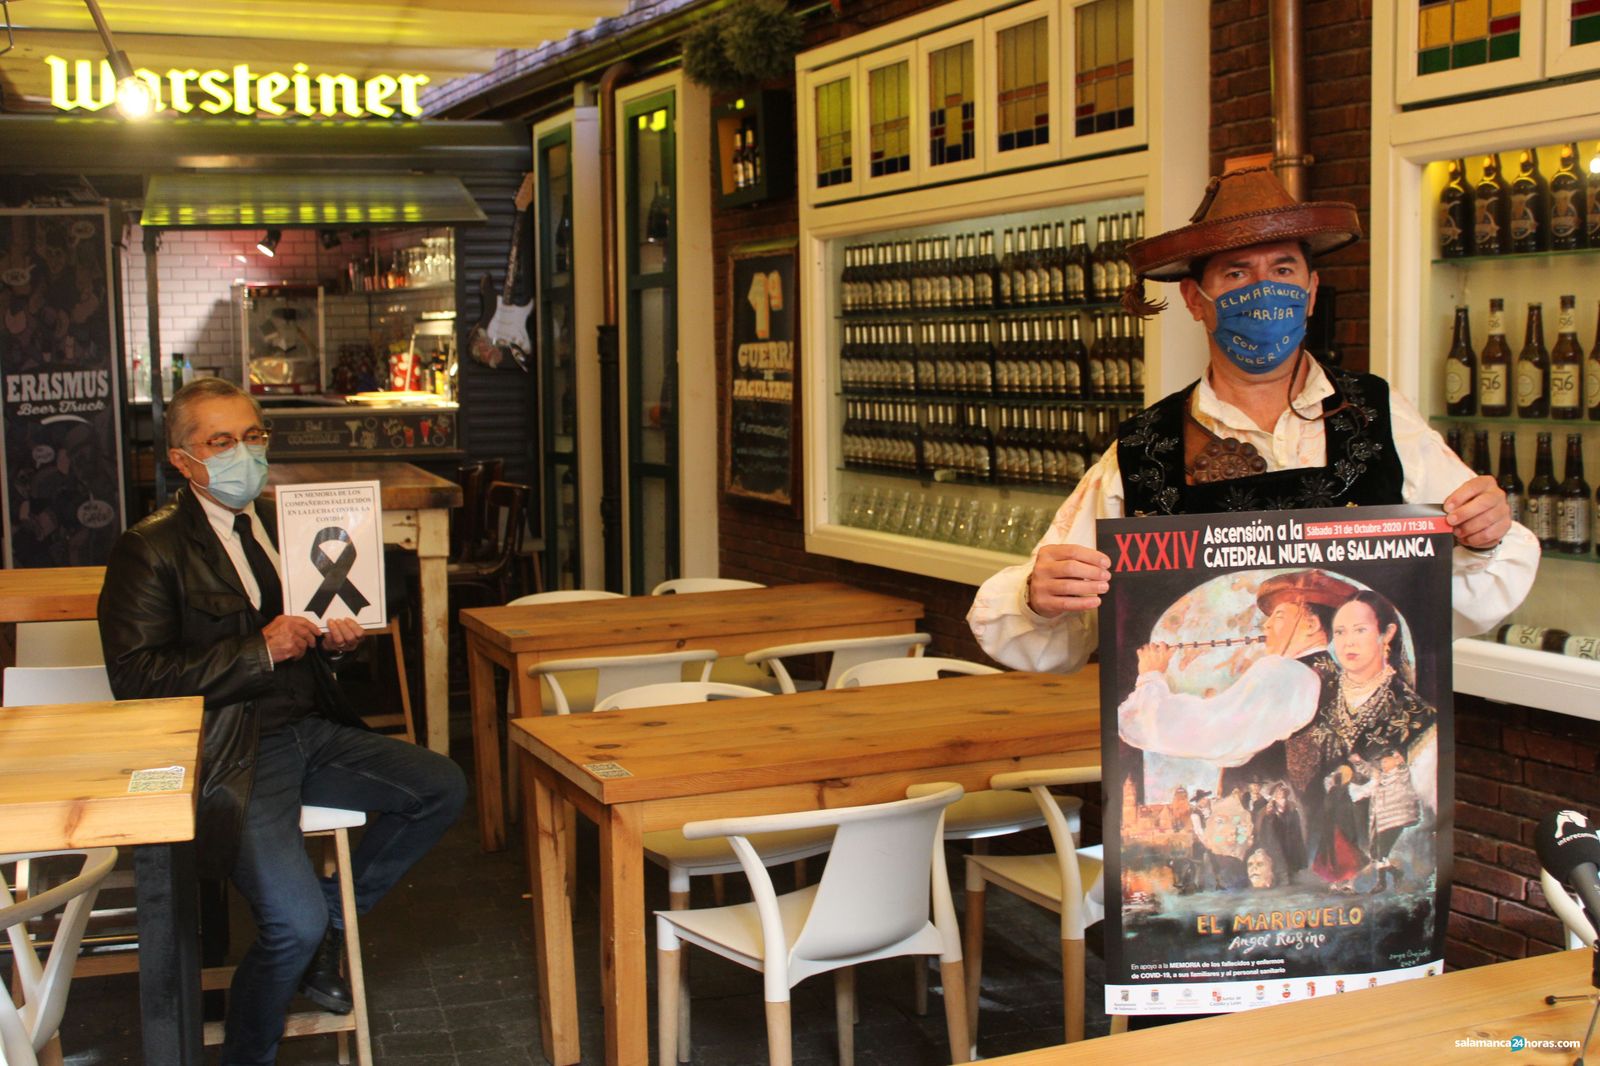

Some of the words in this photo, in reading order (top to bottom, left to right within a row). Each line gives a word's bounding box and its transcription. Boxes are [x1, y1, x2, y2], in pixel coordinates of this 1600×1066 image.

[44, 54, 430, 117] Warsteiner
[6, 370, 109, 402] ERASMUS
[17, 403, 57, 416] Beer
[59, 400, 105, 413] Truck
[305, 490, 338, 498] MEMORIA
[331, 497, 372, 505] FALLECIDOS
[1203, 519, 1274, 545] Ascensión
[1277, 524, 1287, 541] a
[1290, 519, 1303, 540] la
[1306, 525, 1333, 536] Sábado
[1333, 524, 1343, 535] 31
[1343, 524, 1353, 534] de
[1353, 522, 1382, 534] Octubre
[1382, 522, 1402, 533] 2020
[1408, 521, 1427, 531] 11:30
[1114, 530, 1200, 573] XXXIV
[1203, 546, 1276, 568] CATEDRAL
[1278, 543, 1324, 564] NUEVA
[1327, 540, 1345, 562] de
[1347, 537, 1435, 561] SALAMANCA
[1196, 914, 1224, 935] EL
[1233, 907, 1362, 932] MARIQUELO
[1169, 961, 1201, 969] MEMORIA
